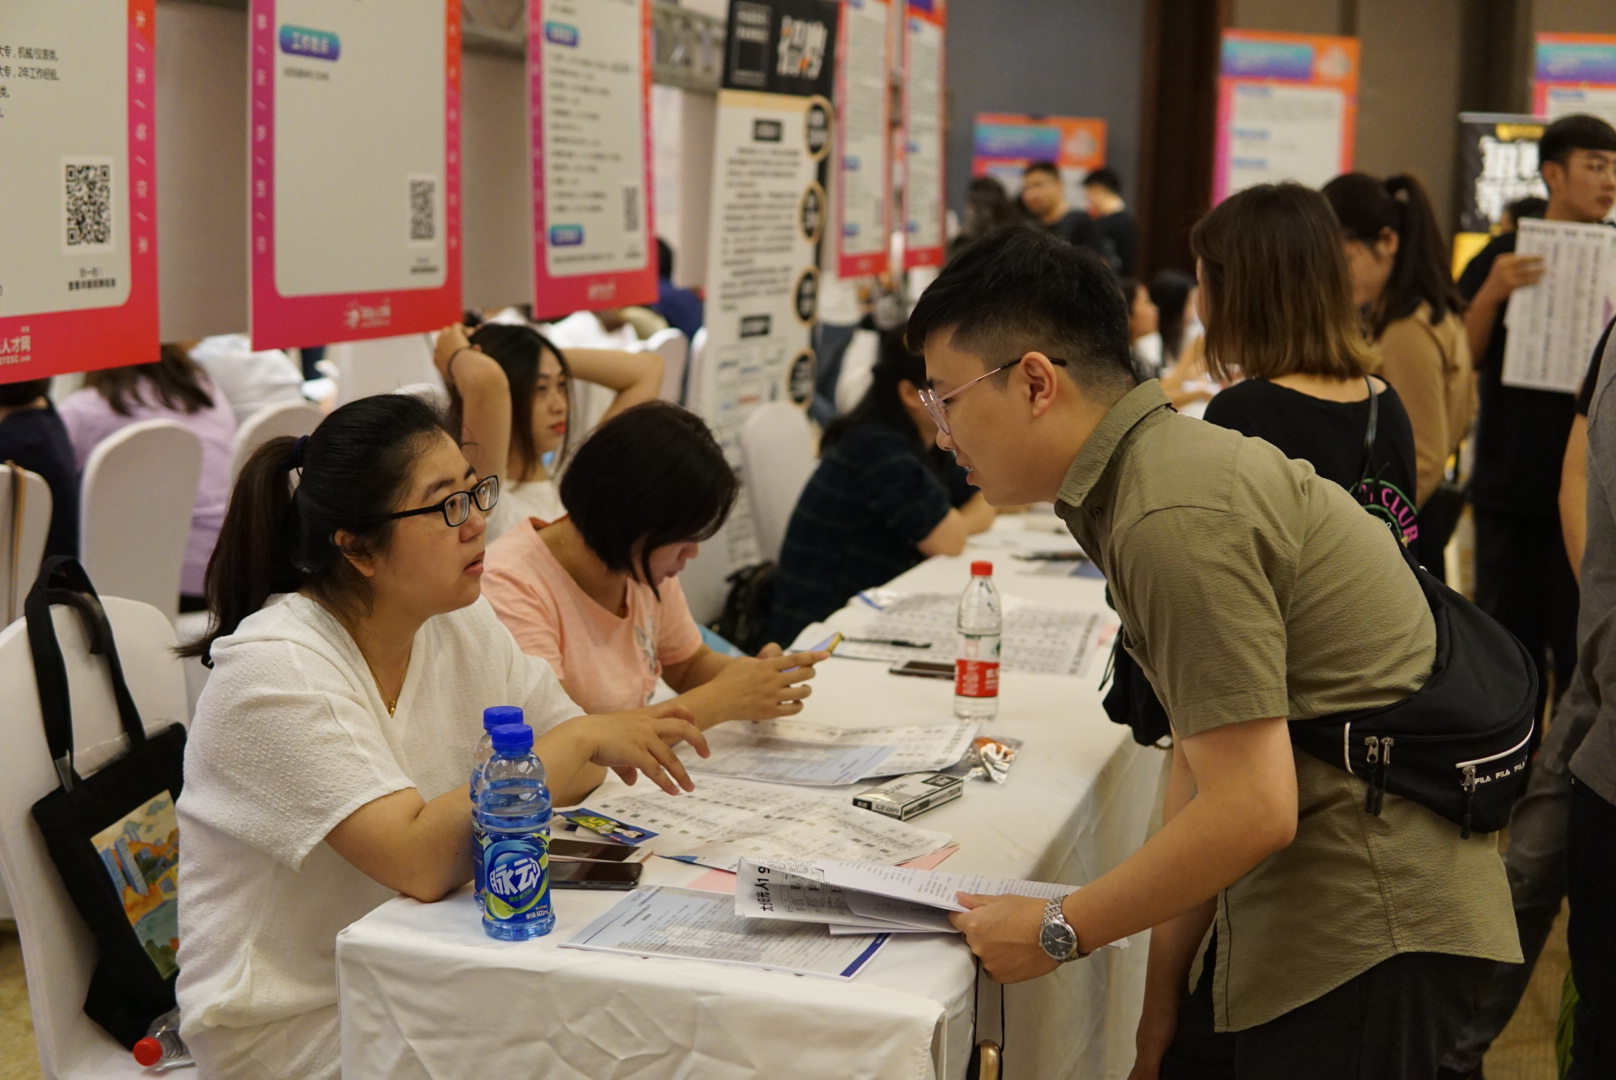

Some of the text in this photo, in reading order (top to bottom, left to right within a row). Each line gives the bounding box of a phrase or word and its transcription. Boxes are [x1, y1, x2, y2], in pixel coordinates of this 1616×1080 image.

[1475, 775, 1492, 785] FILA
[1495, 769, 1511, 780] FILA
[489, 857, 541, 896] 脉动
